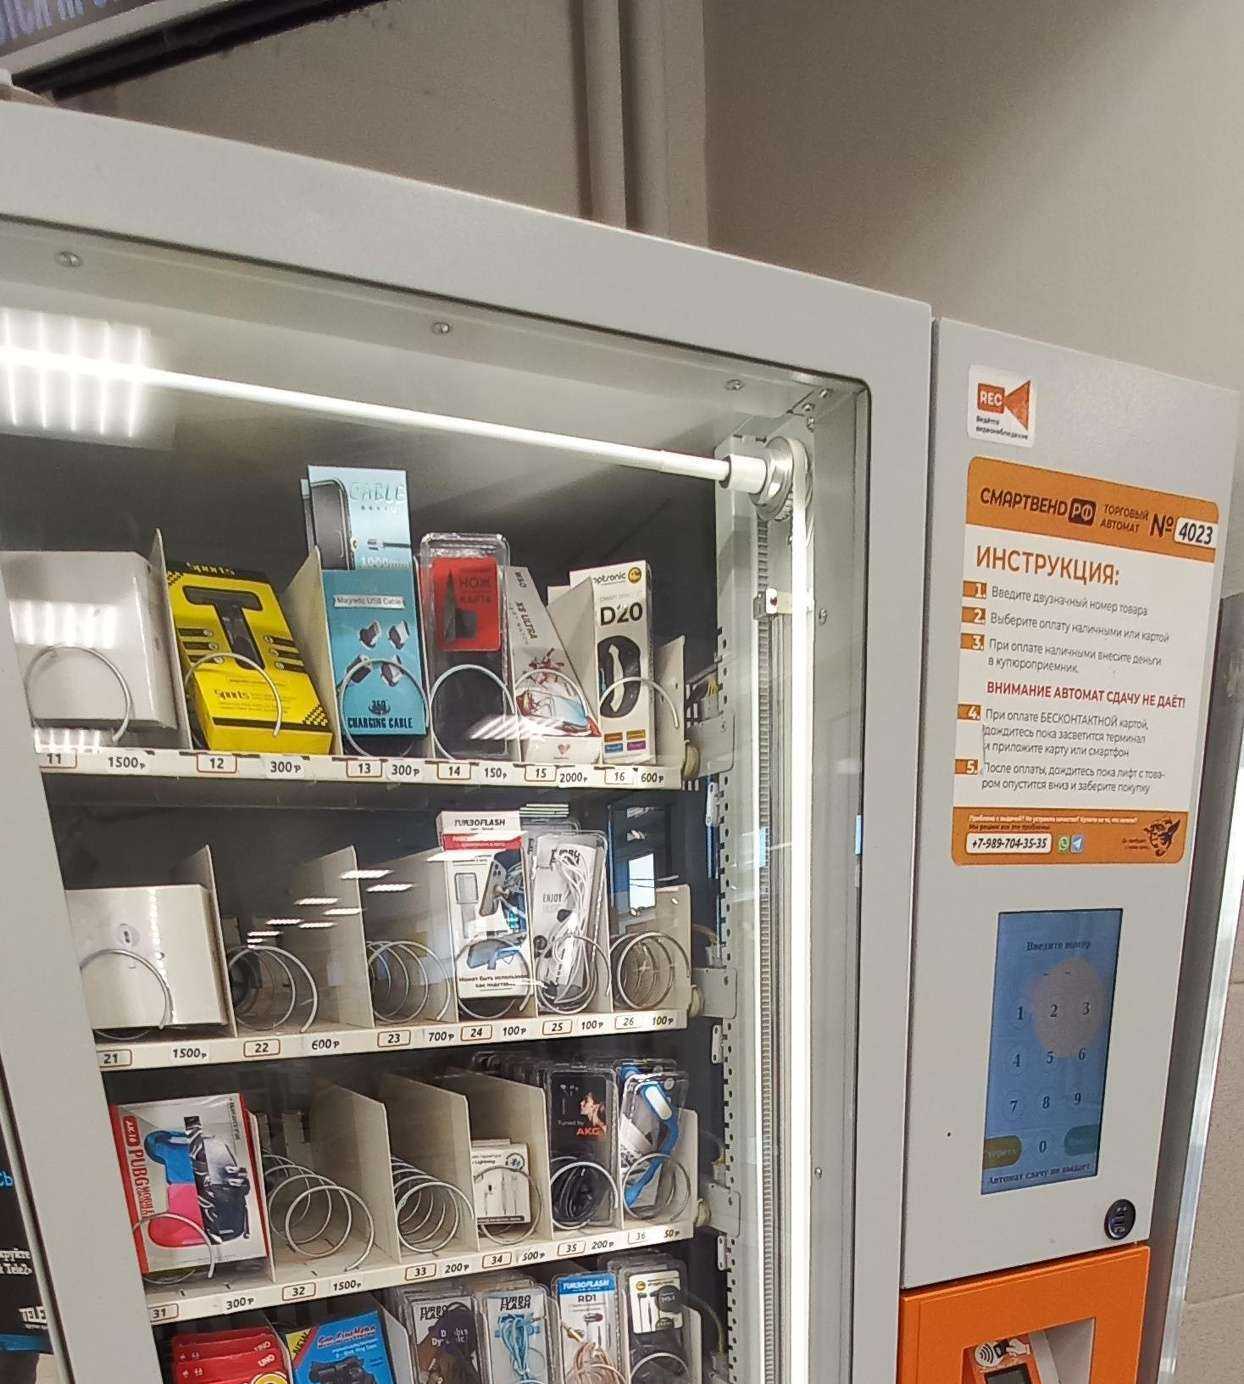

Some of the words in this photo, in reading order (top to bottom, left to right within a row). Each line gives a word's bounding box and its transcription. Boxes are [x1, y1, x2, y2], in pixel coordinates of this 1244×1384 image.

[980, 391, 1002, 406] REC
[1104, 503, 1149, 521] ТОРГОВЫЙ
[1101, 520, 1141, 533] АВТОМАТ
[1178, 522, 1213, 545] 4023
[976, 545, 1120, 585] ИНСТРУКЦИЯ:
[992, 586, 1031, 601] Введите
[1033, 592, 1088, 608] двузначный
[1090, 599, 1118, 613] номер
[1120, 603, 1148, 616] товара
[600, 602, 643, 626] D20
[991, 612, 1037, 629] Выберите
[1039, 621, 1070, 634] оплату
[1072, 624, 1122, 638] наличными
[1123, 629, 1140, 639] или
[1142, 630, 1169, 643] картой
[989, 638, 1009, 651] При
[1011, 642, 1042, 655] оплате
[1044, 647, 1096, 659] наличными
[1098, 652, 1132, 663] внесите
[1133, 655, 1161, 666] деньги
[987, 682, 1051, 698] ВНИМАНИЕ
[1054, 687, 1104, 701] АВТОМАТ
[1106, 691, 1140, 705] СДАЧУ
[1142, 693, 1156, 706] НЕ
[347, 717, 387, 729] CHARGING
[389, 717, 414, 729] CABLE
[986, 709, 1006, 721] При
[1007, 711, 1039, 723] оплате
[1040, 712, 1118, 728] БЕСКОНТАКТНОЙ
[984, 727, 1034, 738] дождитесь
[1036, 730, 1057, 740] пока
[1058, 730, 1104, 742] засветится
[1106, 734, 1145, 745] терминал
[992, 744, 1043, 756] приложите
[1045, 746, 1068, 757] карту
[1070, 747, 1086, 756] или
[1088, 748, 1129, 758] смартфон
[46, 753, 62, 765] 11
[210, 758, 224, 769] 12
[358, 763, 371, 774] 13
[447, 766, 461, 777] 14
[535, 768, 547, 779] 15
[1049, 766, 1094, 777] дождитесь
[1096, 768, 1115, 778] пока
[614, 771, 626, 782] 16
[982, 781, 1000, 790] ром
[1002, 781, 1046, 792] опустится
[1048, 782, 1069, 790] вниз
[1078, 782, 1116, 793] заберите
[1118, 784, 1150, 794] покупку
[972, 838, 1047, 849] +7-989-704-35-35
[1018, 1006, 1024, 1020] 1
[1050, 1004, 1058, 1018] 2
[1082, 1002, 1090, 1016] 3
[552, 1022, 564, 1032] 25
[623, 1017, 634, 1026] 26
[388, 1033, 400, 1044] 23
[470, 1028, 483, 1038] 24
[255, 1042, 269, 1053] 22
[103, 1053, 118, 1064] 21
[1013, 1054, 1020, 1067] 4
[1046, 1051, 1053, 1064] 5
[1079, 1048, 1086, 1061] 6
[1011, 1100, 1018, 1113] 7
[1042, 1097, 1050, 1109] 8
[1074, 1093, 1082, 1105] 9
[1039, 1141, 1046, 1153] 0
[128, 1149, 150, 1187] PUBG
[565, 1243, 577, 1253] 35
[491, 1254, 503, 1264] 34
[414, 1267, 427, 1277] 33
[292, 1286, 306, 1297] 32
[500, 1295, 531, 1305] TURBO
[500, 1301, 531, 1311] FLASH
[152, 1308, 167, 1319] 31
